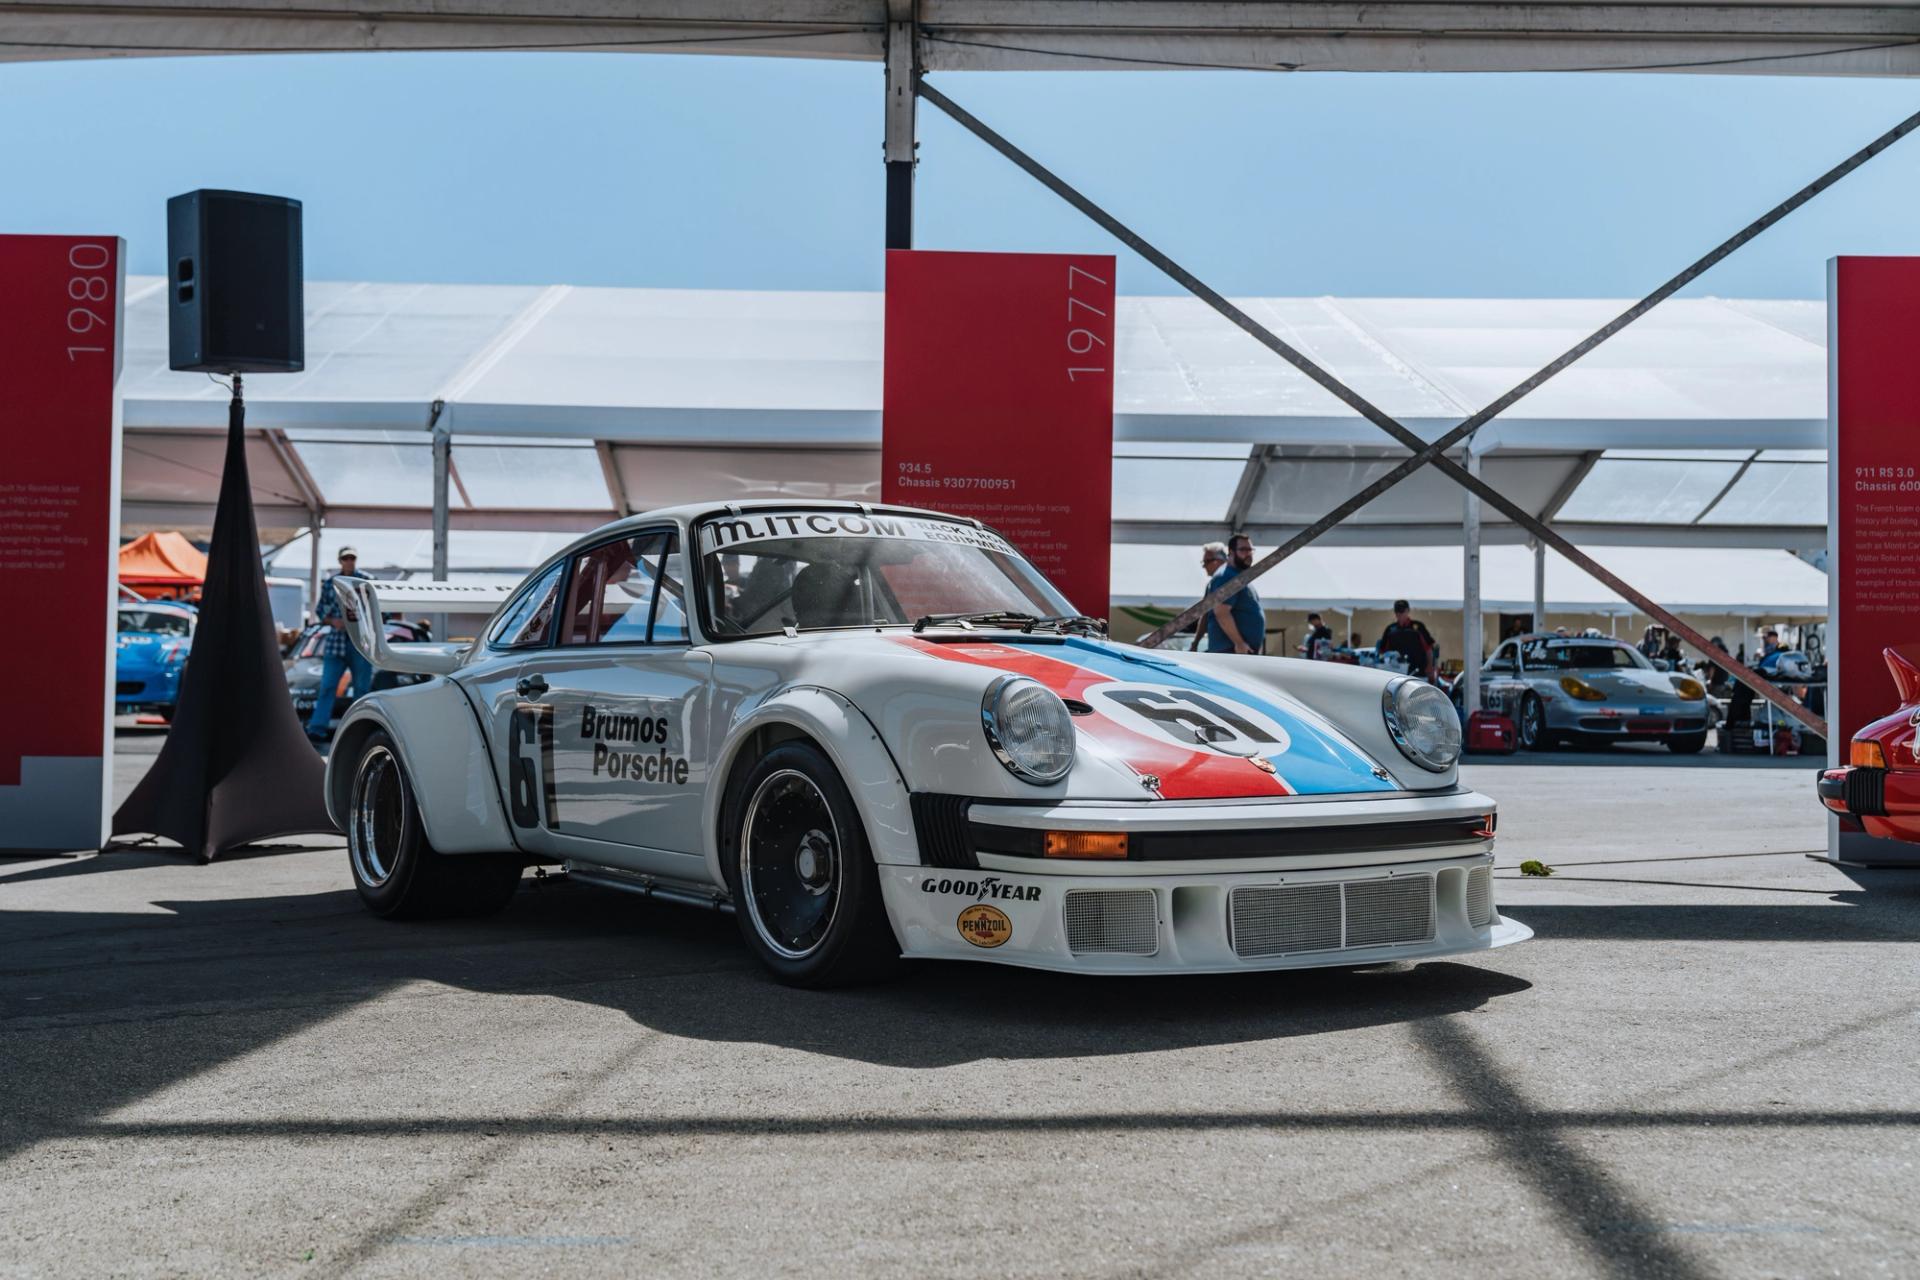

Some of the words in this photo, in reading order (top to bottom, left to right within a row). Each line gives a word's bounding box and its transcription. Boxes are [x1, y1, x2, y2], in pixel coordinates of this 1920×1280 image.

[67, 244, 109, 361] 1980
[1067, 265, 1107, 382] 1977
[898, 475, 941, 488] Chassis
[943, 476, 1016, 490] 9307700951
[899, 462, 932, 474] 934.5
[1855, 467, 1875, 478] 911
[1879, 467, 1894, 478] RS
[1896, 467, 1914, 478] 3.0
[1855, 480, 1897, 491] Chassis
[580, 705, 668, 744] Brumos
[1102, 689, 1281, 744] 61
[509, 704, 560, 830] 61
[593, 742, 689, 785] Porsche
[962, 919, 1007, 932] PENNZOIL
